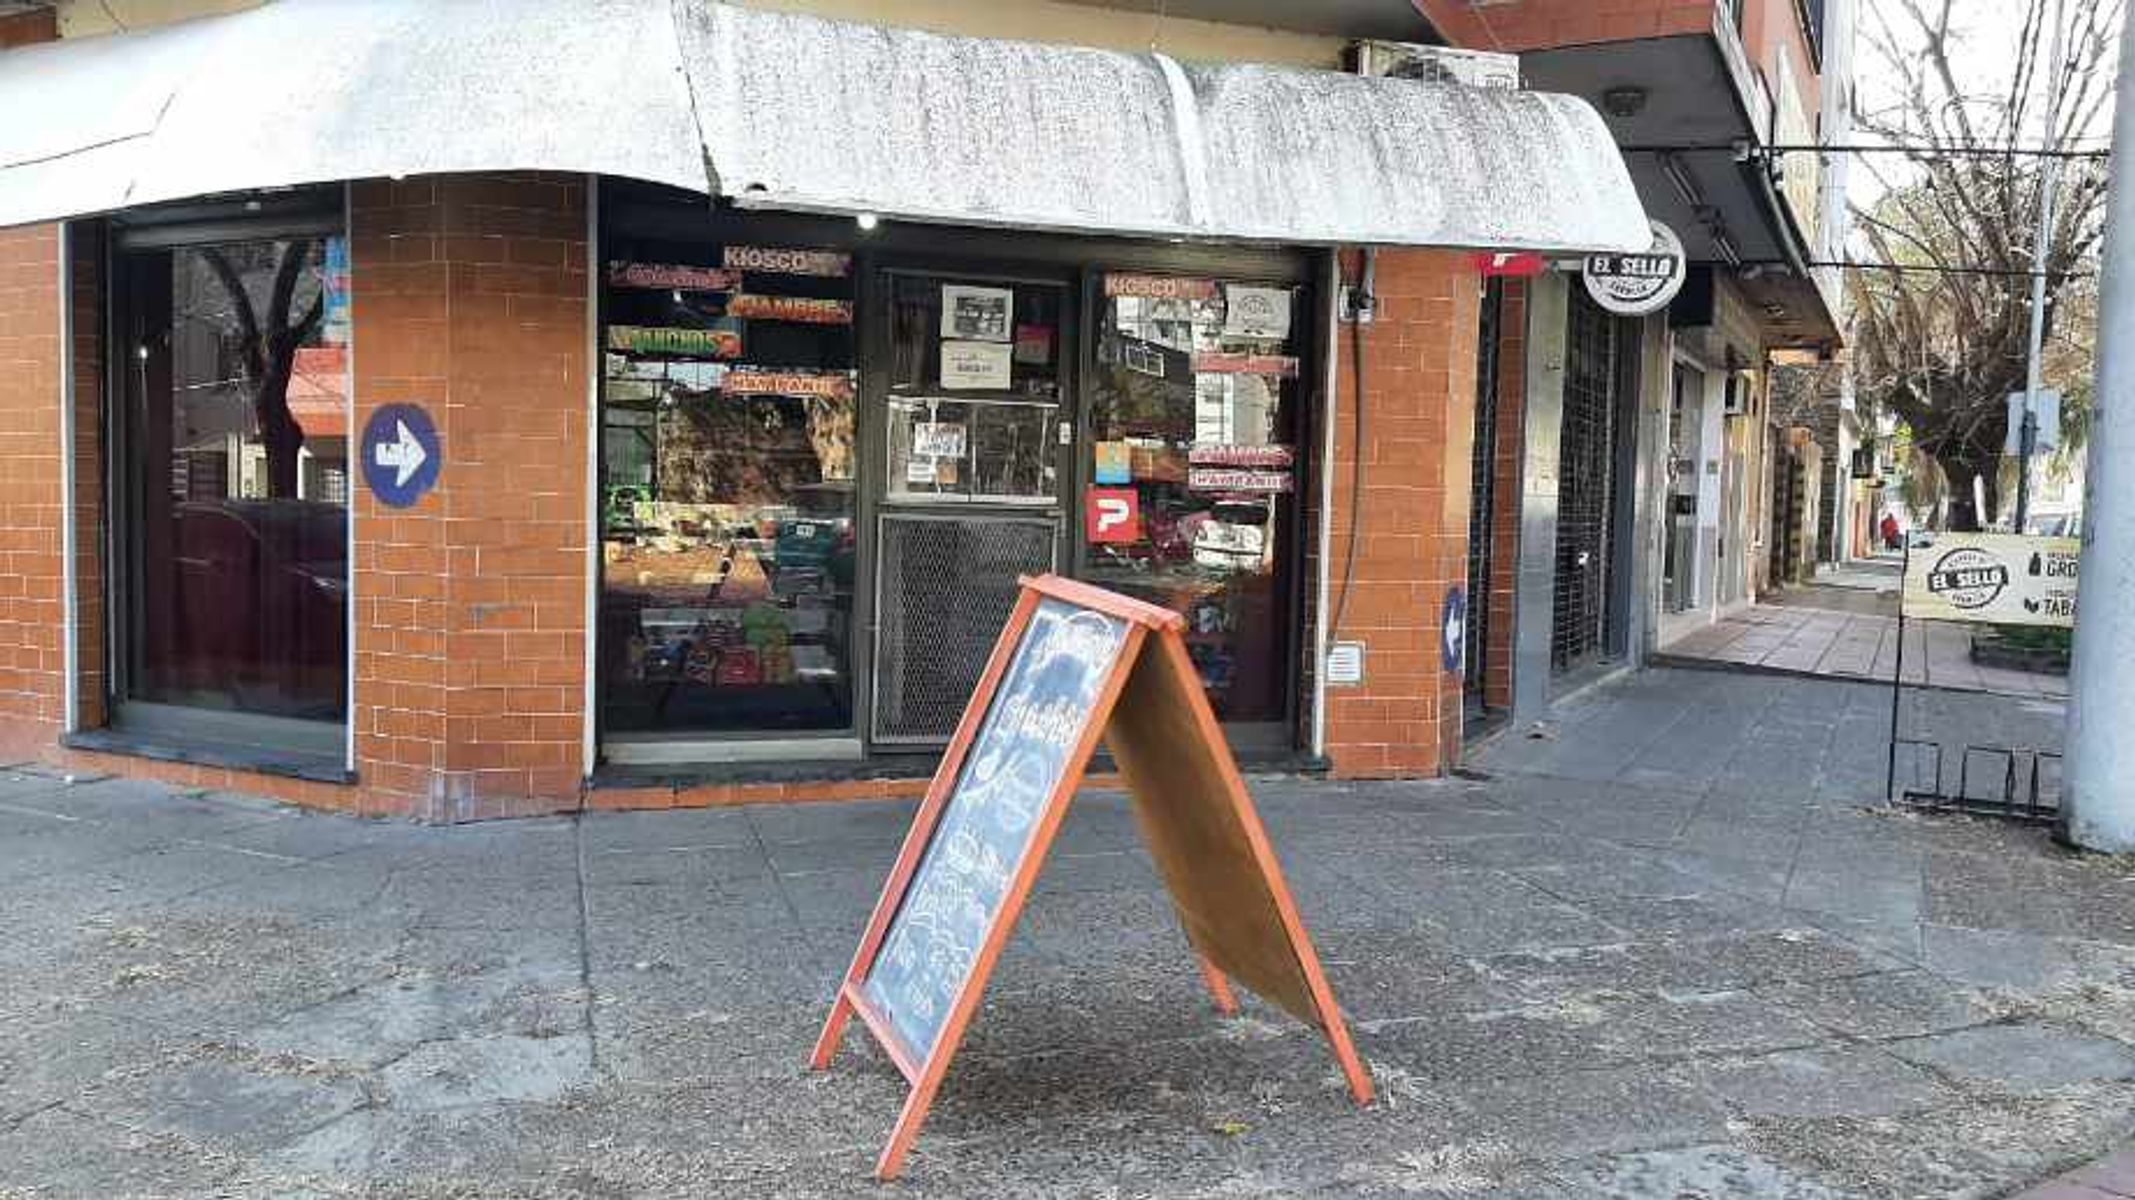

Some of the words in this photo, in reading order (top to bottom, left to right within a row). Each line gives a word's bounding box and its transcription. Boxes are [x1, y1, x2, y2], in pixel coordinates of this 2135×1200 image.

[724, 245, 808, 270] KIOSCO
[1594, 256, 1611, 274] EL
[1620, 257, 1671, 276] SELLO
[1932, 572, 1948, 589] EL
[1956, 569, 2002, 587] SELLO
